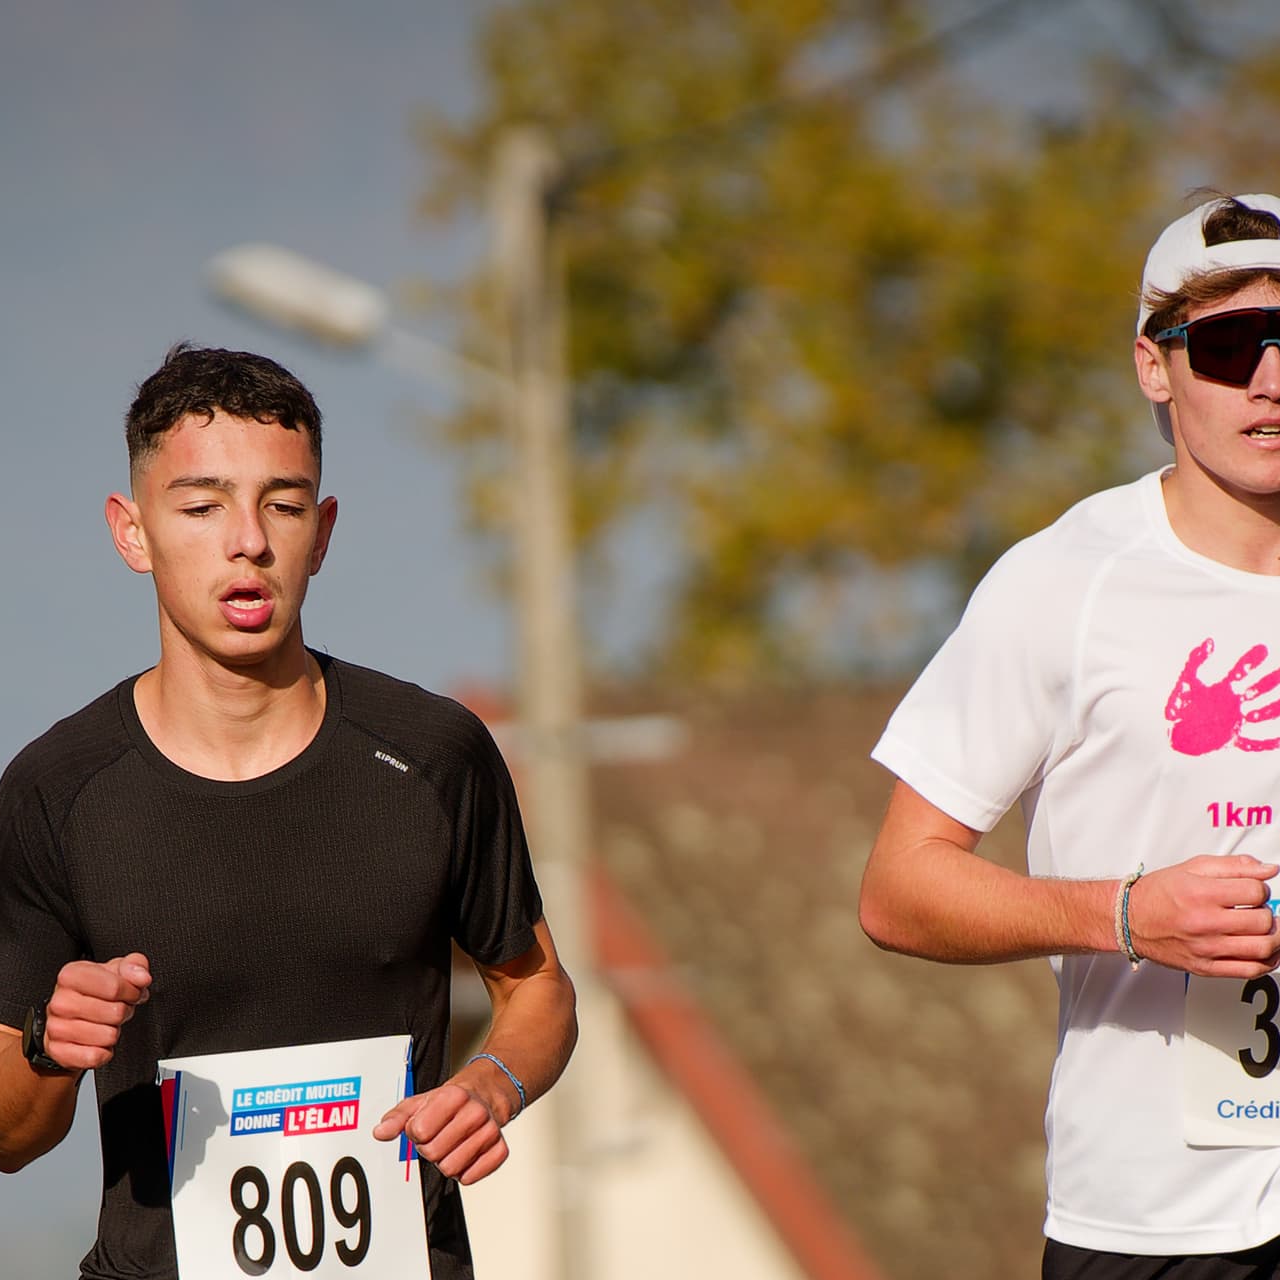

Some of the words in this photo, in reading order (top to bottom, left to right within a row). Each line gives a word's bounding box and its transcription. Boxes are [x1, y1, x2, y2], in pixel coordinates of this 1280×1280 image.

[374, 750, 409, 773] KIPRUN
[1207, 801, 1272, 828] 1km
[236, 1093, 253, 1108] LE
[255, 1087, 304, 1106] CRÉDIT
[305, 1082, 357, 1101] MUTUEL
[234, 1113, 281, 1132] DONNE
[288, 1104, 355, 1132] L'ÉLAN
[230, 1156, 371, 1276] 809
